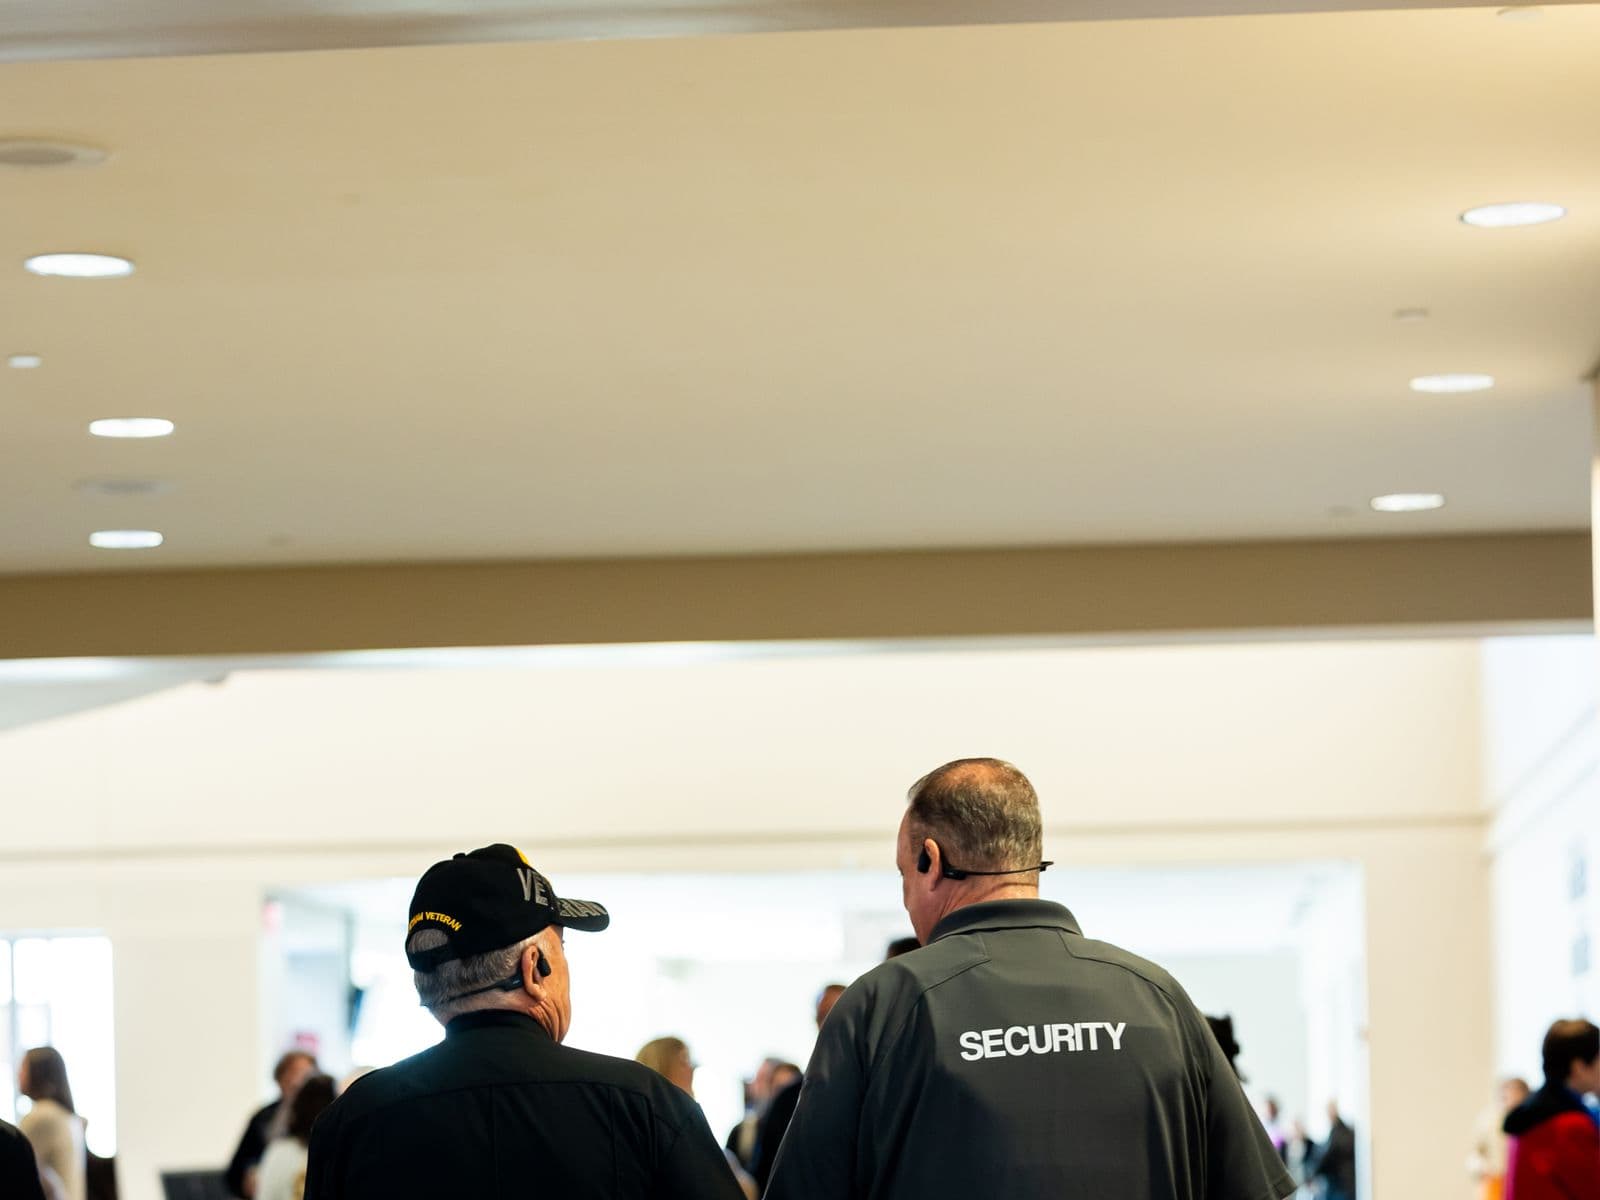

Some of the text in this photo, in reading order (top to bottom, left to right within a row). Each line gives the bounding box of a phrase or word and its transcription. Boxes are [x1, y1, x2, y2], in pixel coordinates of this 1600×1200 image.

[516, 867, 552, 906] VE
[425, 911, 463, 932] VETERAN
[959, 1022, 1127, 1061] SECURITY
